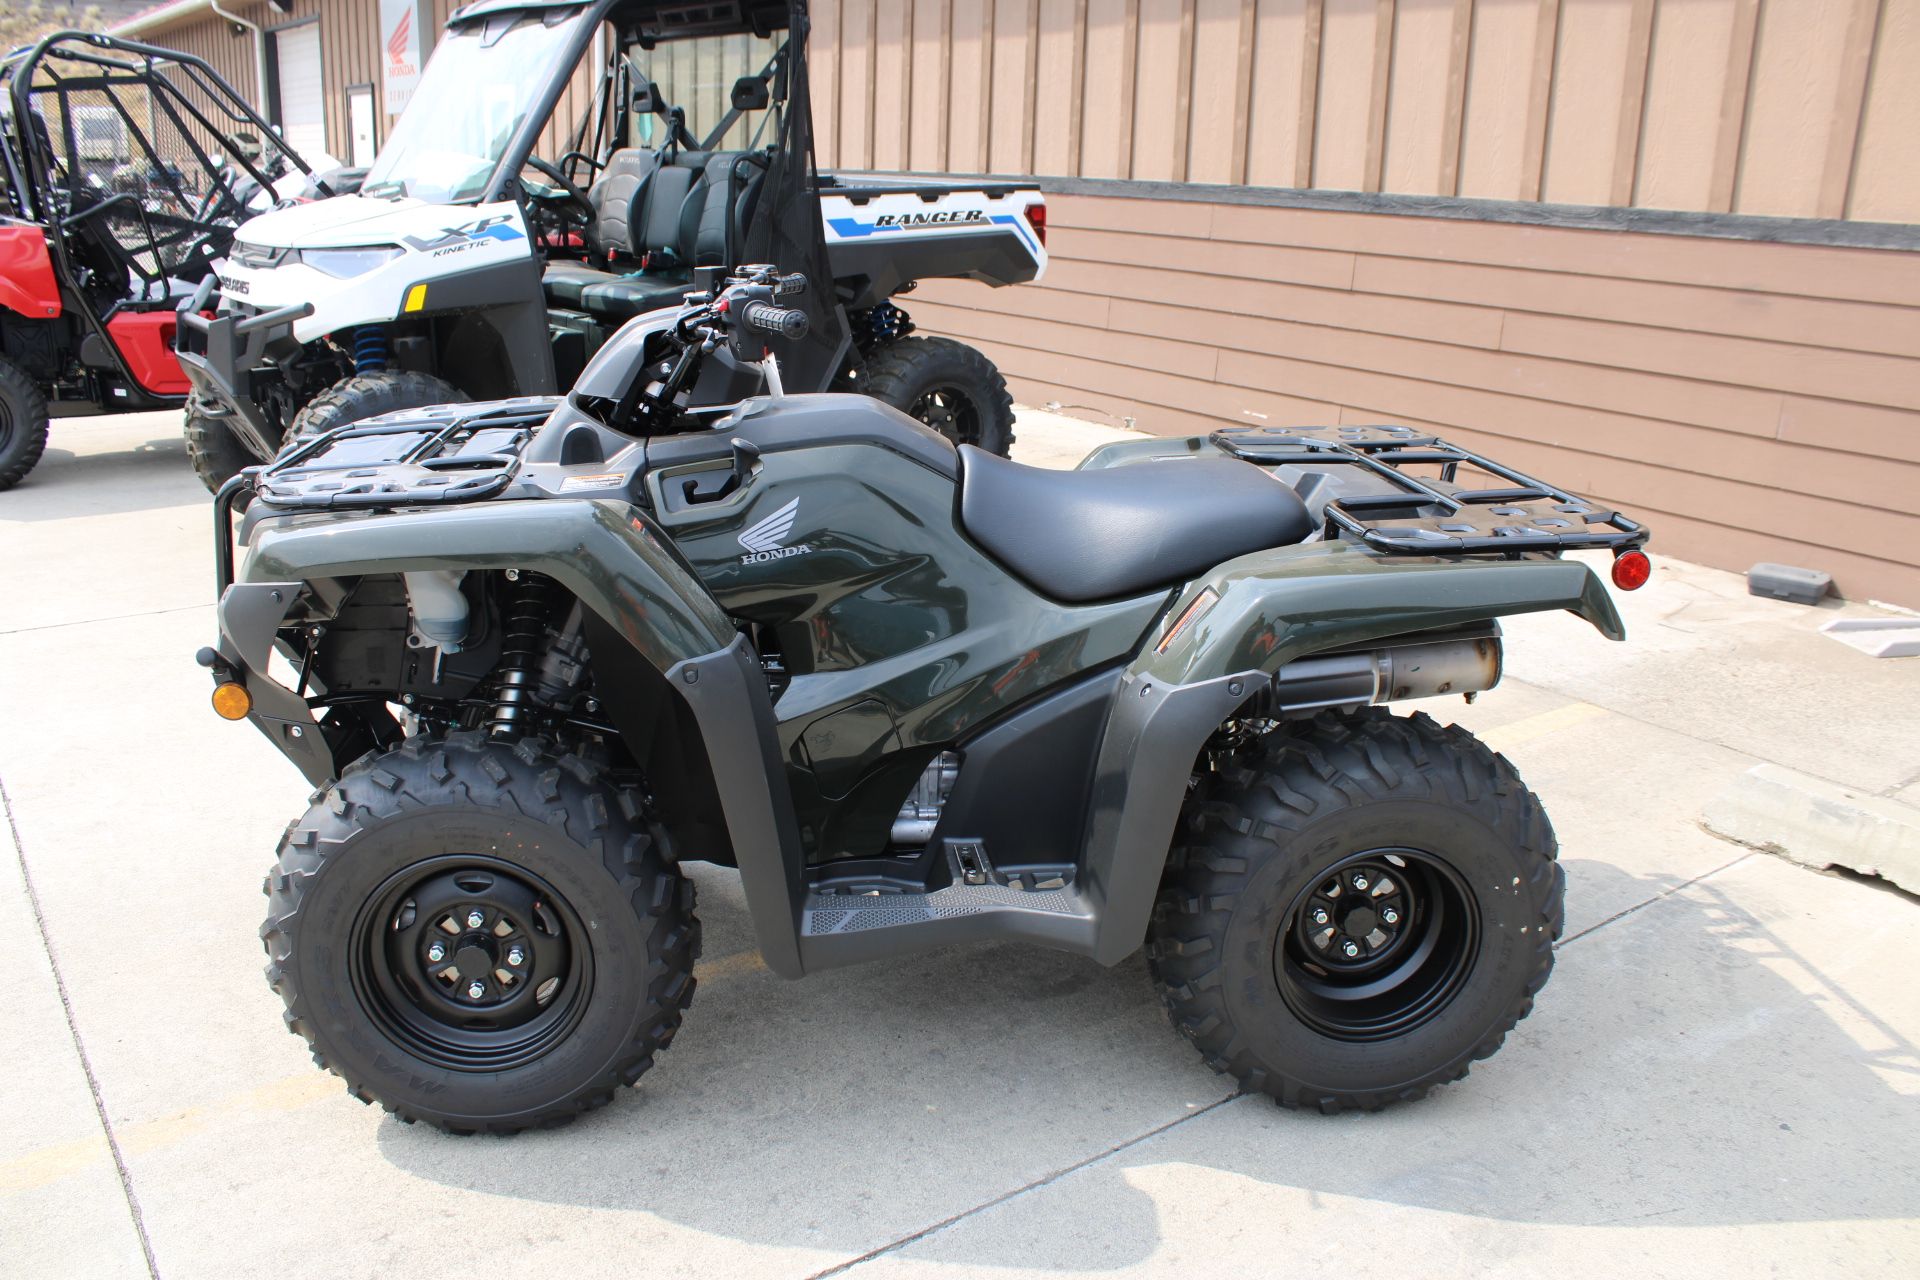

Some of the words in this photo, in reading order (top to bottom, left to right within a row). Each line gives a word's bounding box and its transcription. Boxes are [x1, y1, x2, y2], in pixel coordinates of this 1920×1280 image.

[388, 64, 416, 78] HONDA
[874, 209, 983, 227] RANGER
[433, 239, 491, 257] KINETIC
[741, 545, 812, 565] HONDA
